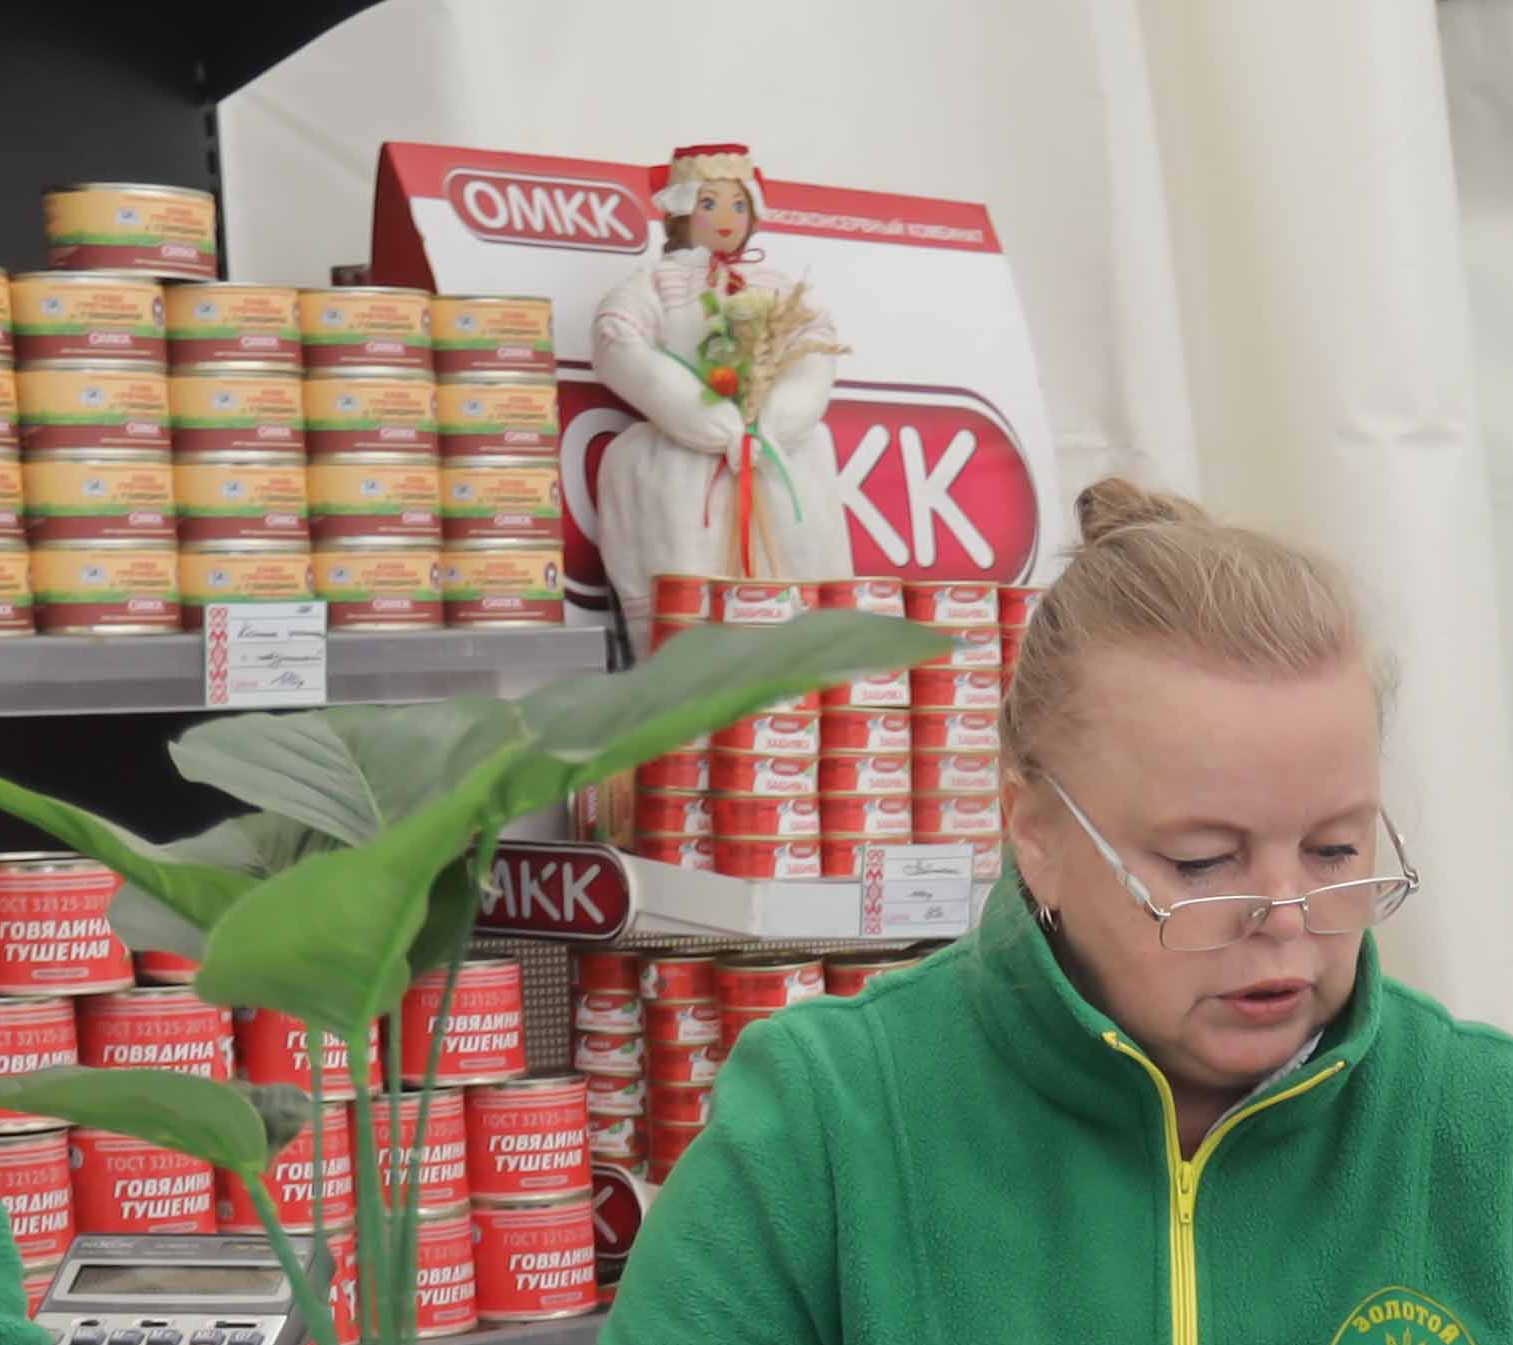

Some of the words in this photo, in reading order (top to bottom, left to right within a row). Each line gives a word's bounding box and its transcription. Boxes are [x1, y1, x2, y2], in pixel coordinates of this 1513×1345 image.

[463, 180, 634, 241] ОМКК
[5, 939, 111, 963] ТУШЕНАЯ
[103, 1041, 215, 1064] ГОВЯДИНА
[489, 1129, 585, 1153] ГОВЯДИНА
[494, 1148, 584, 1173] ТУШЕНАЯ
